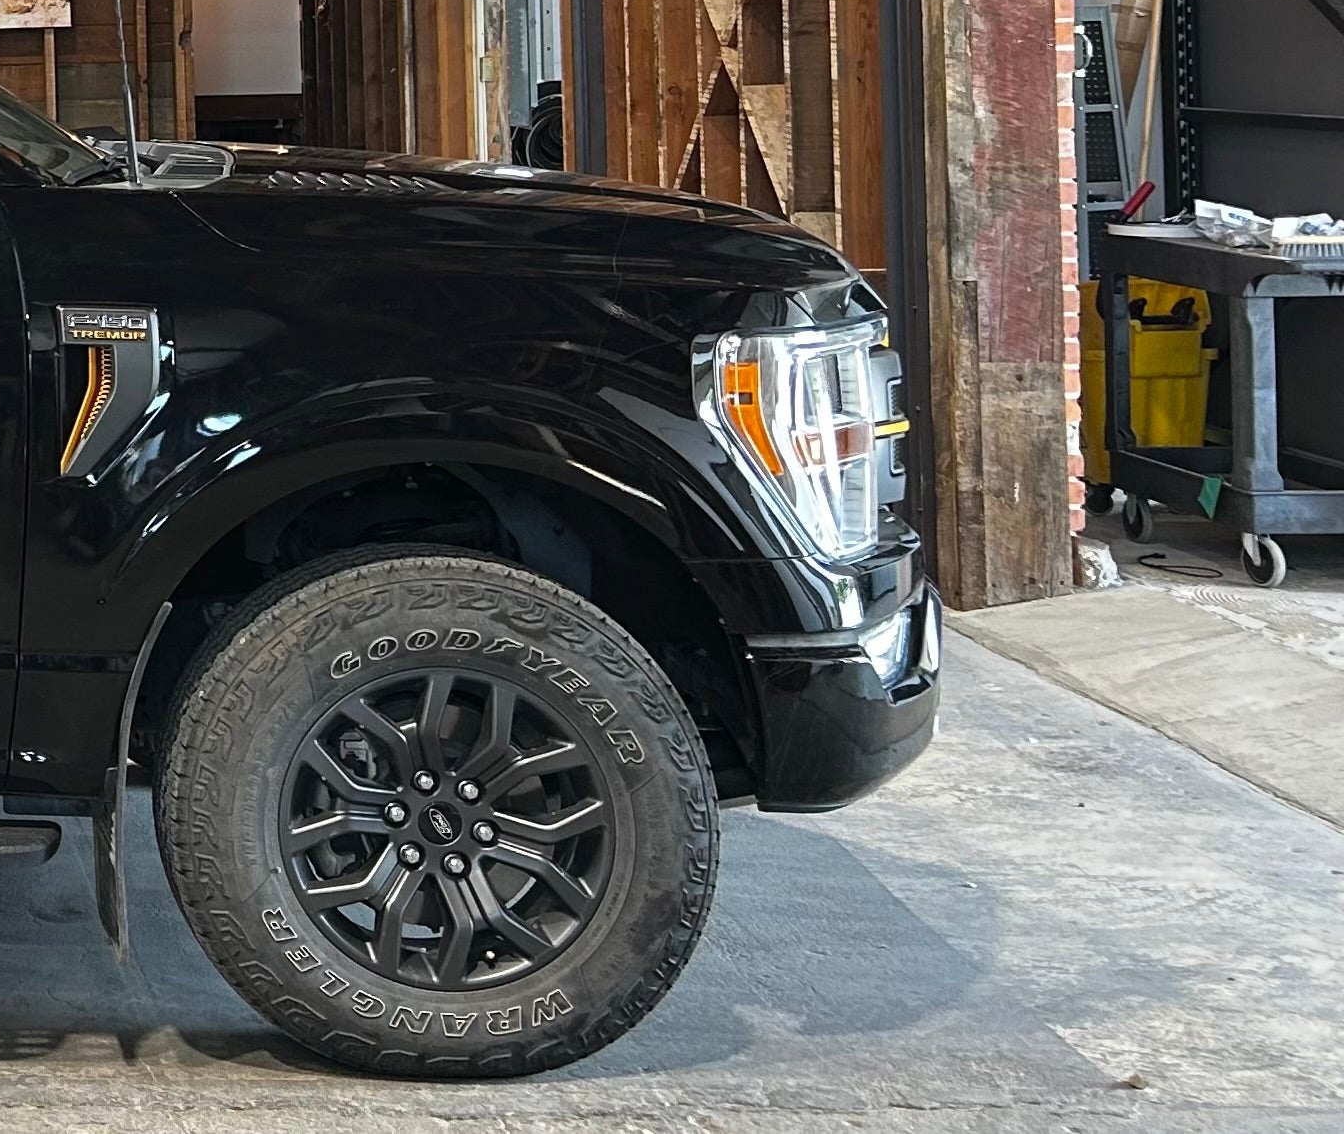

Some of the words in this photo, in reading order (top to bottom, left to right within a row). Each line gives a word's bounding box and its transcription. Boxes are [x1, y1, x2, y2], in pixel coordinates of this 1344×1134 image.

[67, 314, 148, 329] F-150
[70, 330, 146, 340] TREMOR
[329, 627, 646, 767] GOODYEAR
[260, 905, 574, 1038] WRANGLER
